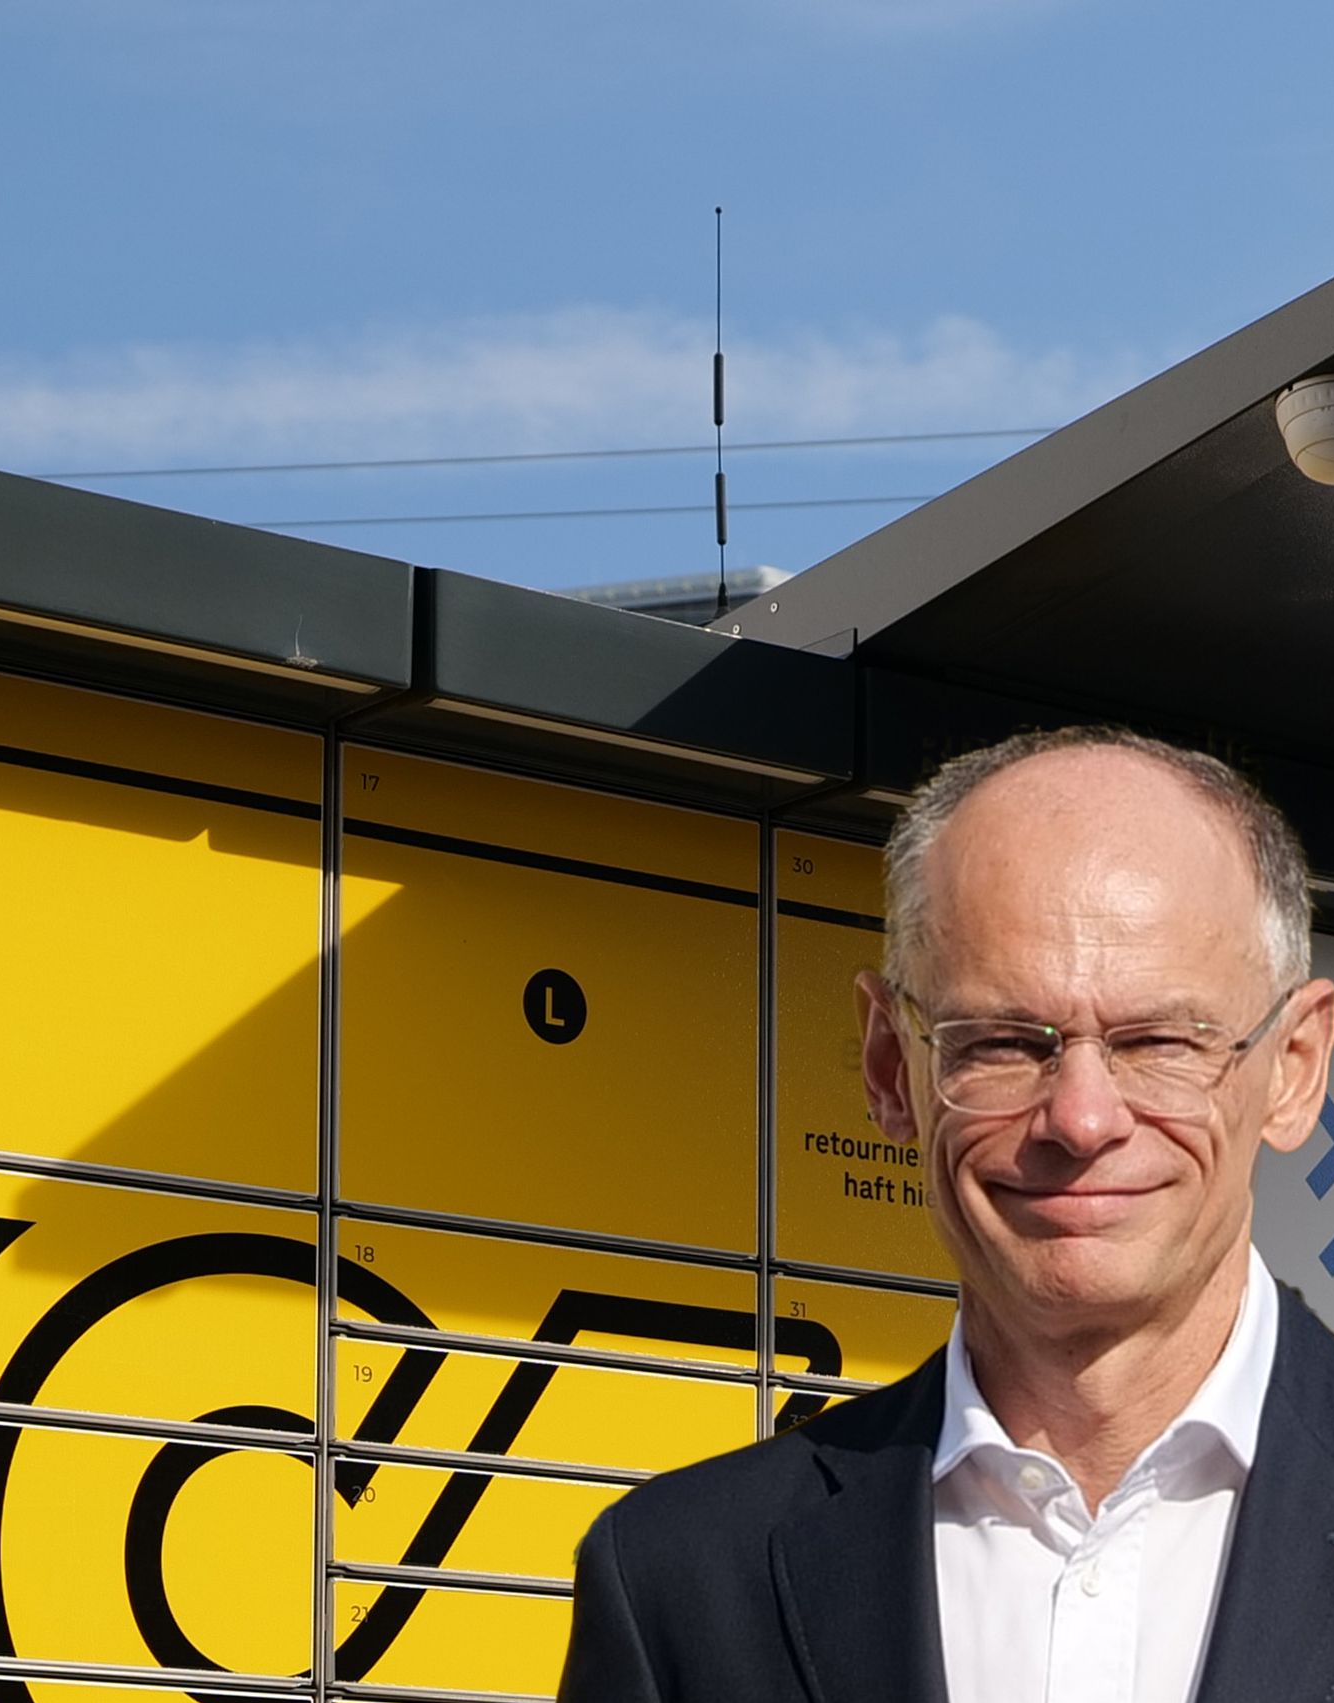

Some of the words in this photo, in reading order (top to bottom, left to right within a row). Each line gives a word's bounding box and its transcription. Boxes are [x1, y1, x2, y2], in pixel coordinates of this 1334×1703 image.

[361, 773, 379, 791] 17
[793, 856, 815, 876] 30
[546, 987, 564, 1026] L
[805, 1131, 924, 1167] retournie
[845, 1172, 895, 1203] haft
[353, 1245, 375, 1264] 18
[790, 1301, 806, 1318] 31
[354, 1365, 372, 1382] 19
[350, 1485, 376, 1504] 20
[350, 1606, 369, 1623] 21
